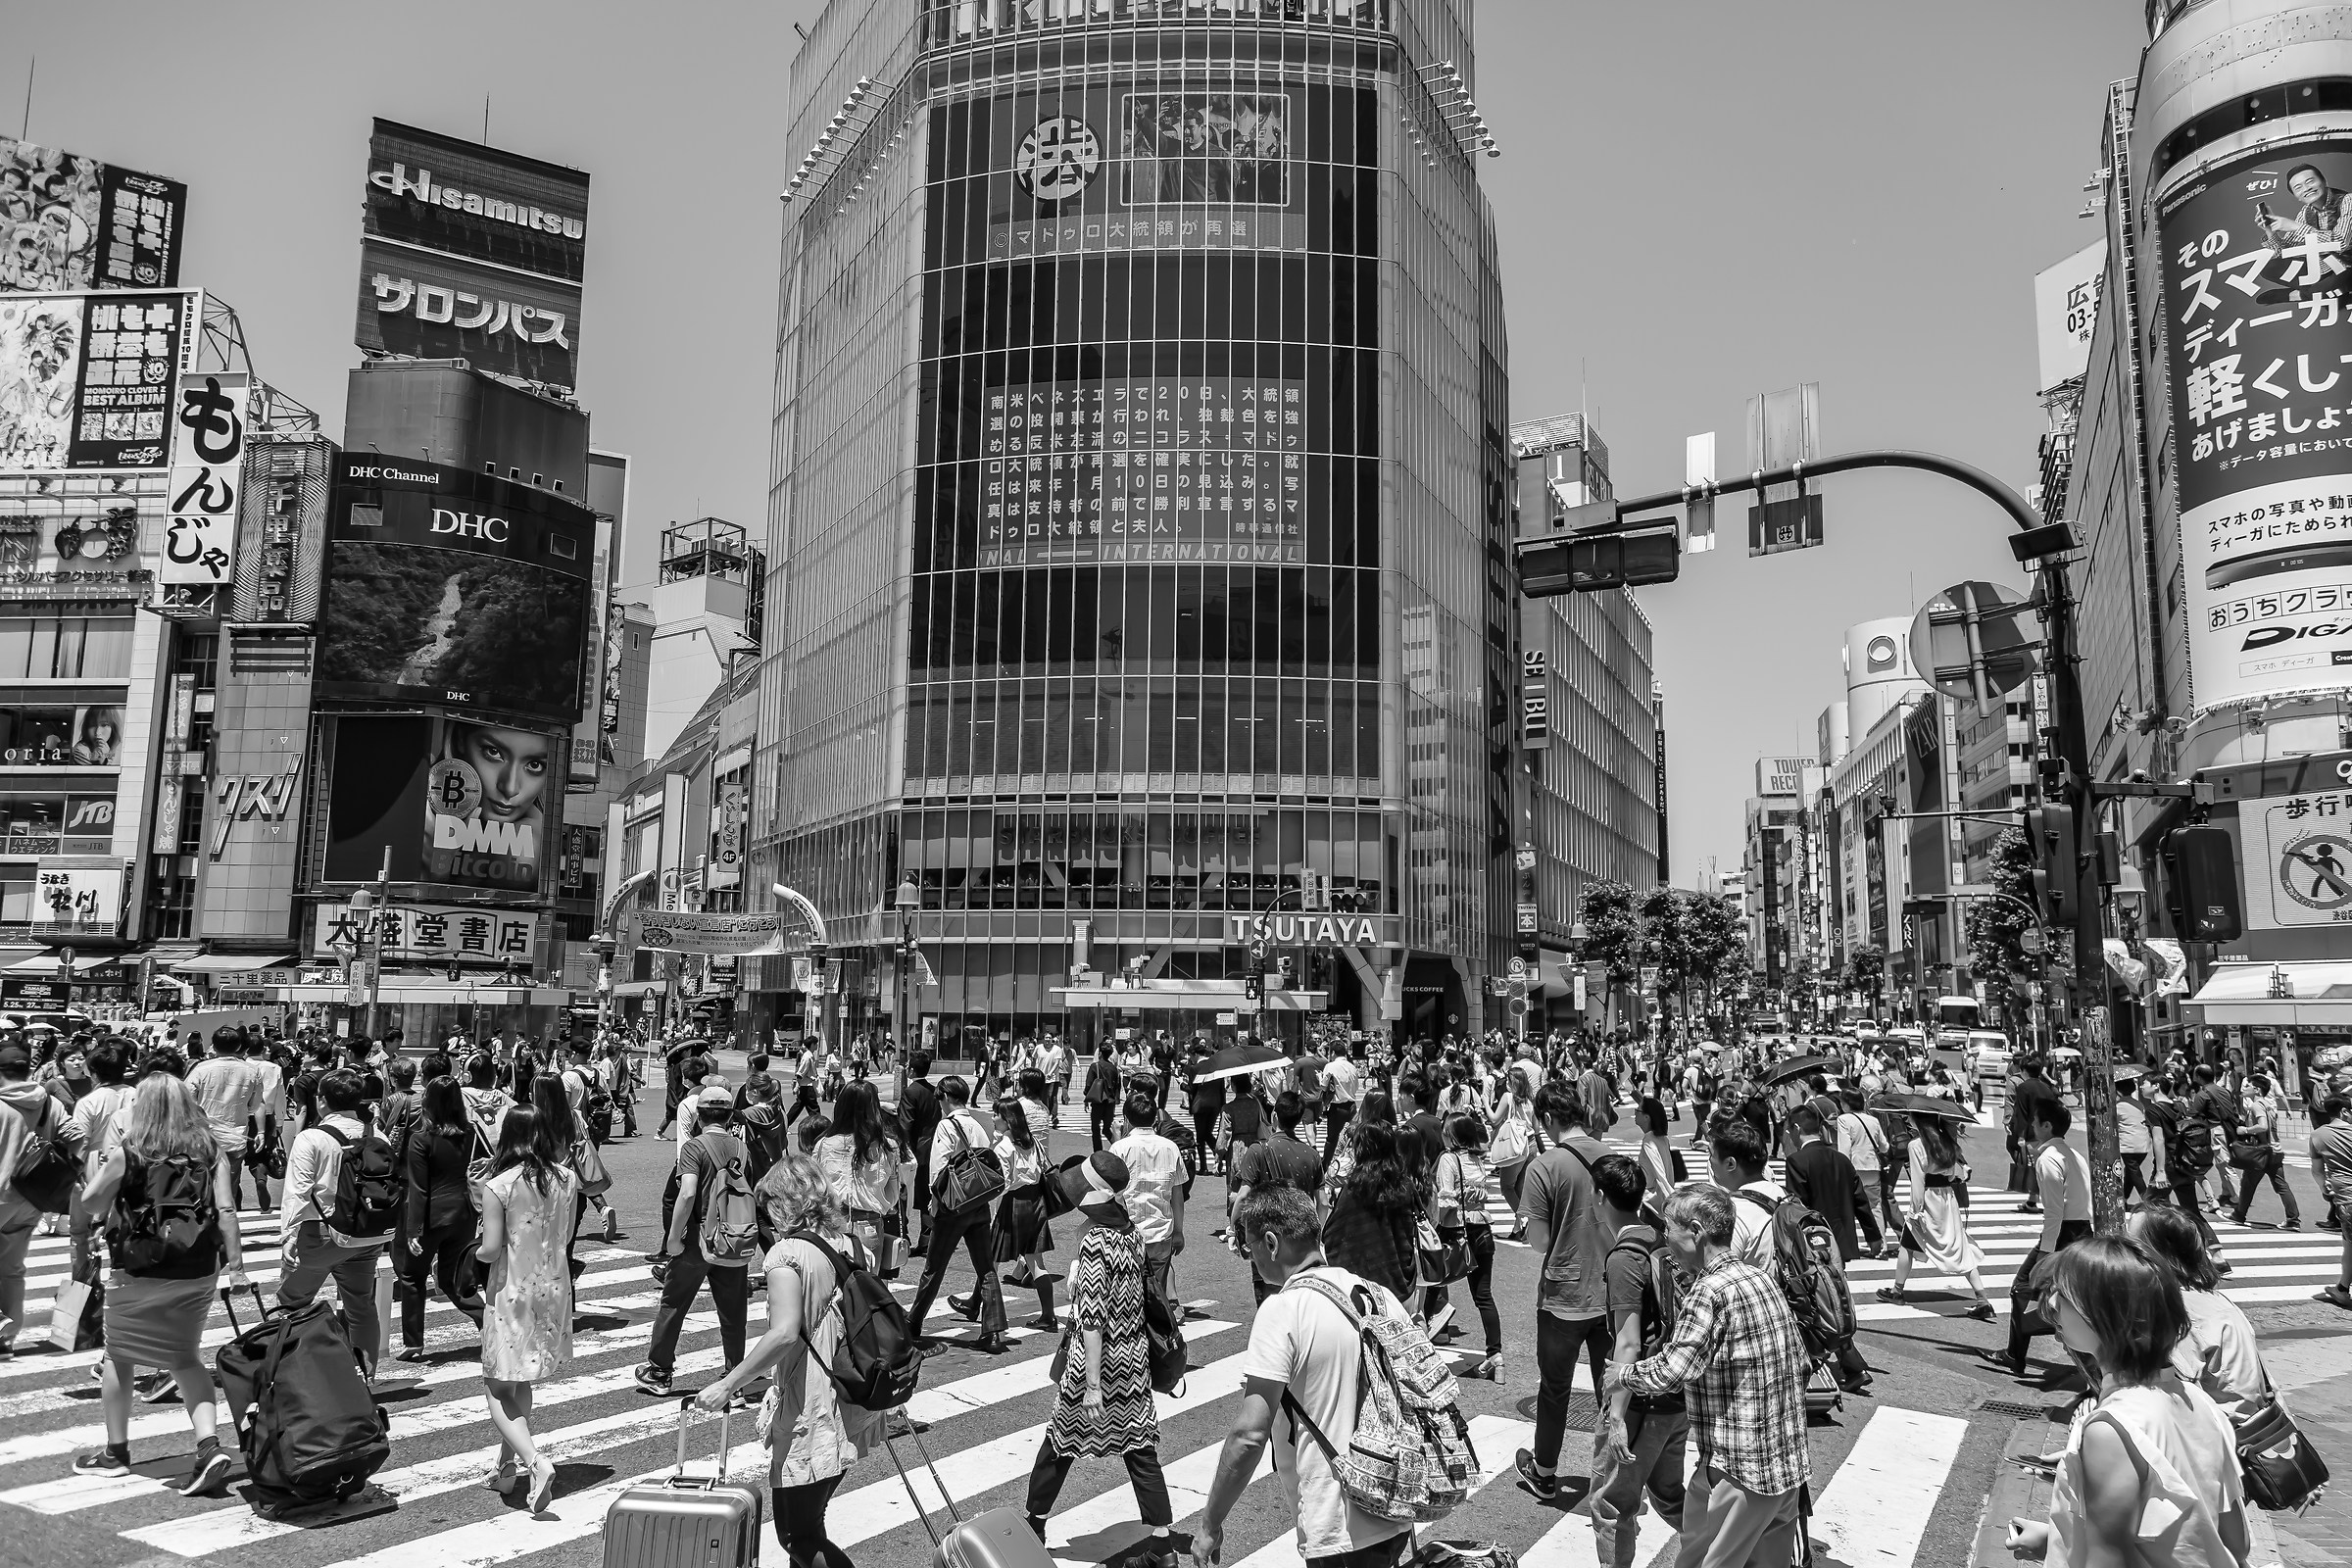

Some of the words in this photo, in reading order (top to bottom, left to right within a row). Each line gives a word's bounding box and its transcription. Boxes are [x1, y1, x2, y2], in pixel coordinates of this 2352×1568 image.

[369, 162, 584, 239] Hisamitsu
[2162, 183, 2207, 217] Panasonic
[2178, 229, 2230, 269] その
[2180, 233, 2347, 324] スマホ
[371, 272, 569, 350] サロンパス
[83, 395, 116, 407] BEST
[117, 394, 167, 406] ALBUM
[2191, 404, 2352, 463] あげましょ
[168, 377, 243, 578] もんじゃ
[349, 466, 380, 478] DHC
[382, 467, 440, 484] Channel
[429, 508, 510, 543] DHC
[1102, 544, 1299, 563] INTERNATIONAL
[446, 691, 470, 703] DHC
[1524, 651, 1546, 743] SEIBU
[69, 800, 114, 828] JTB
[209, 752, 303, 855] クスリ
[433, 813, 535, 858] DMM
[1795, 826, 1805, 877] KARAOKE
[430, 849, 534, 882] Bitcoin
[723, 852, 736, 861] 4F
[325, 912, 531, 955] 大盛堂書店
[1231, 915, 1377, 943] TSUTAYA
[1520, 913, 1535, 928] 本
[1903, 914, 1913, 949] ZARA
